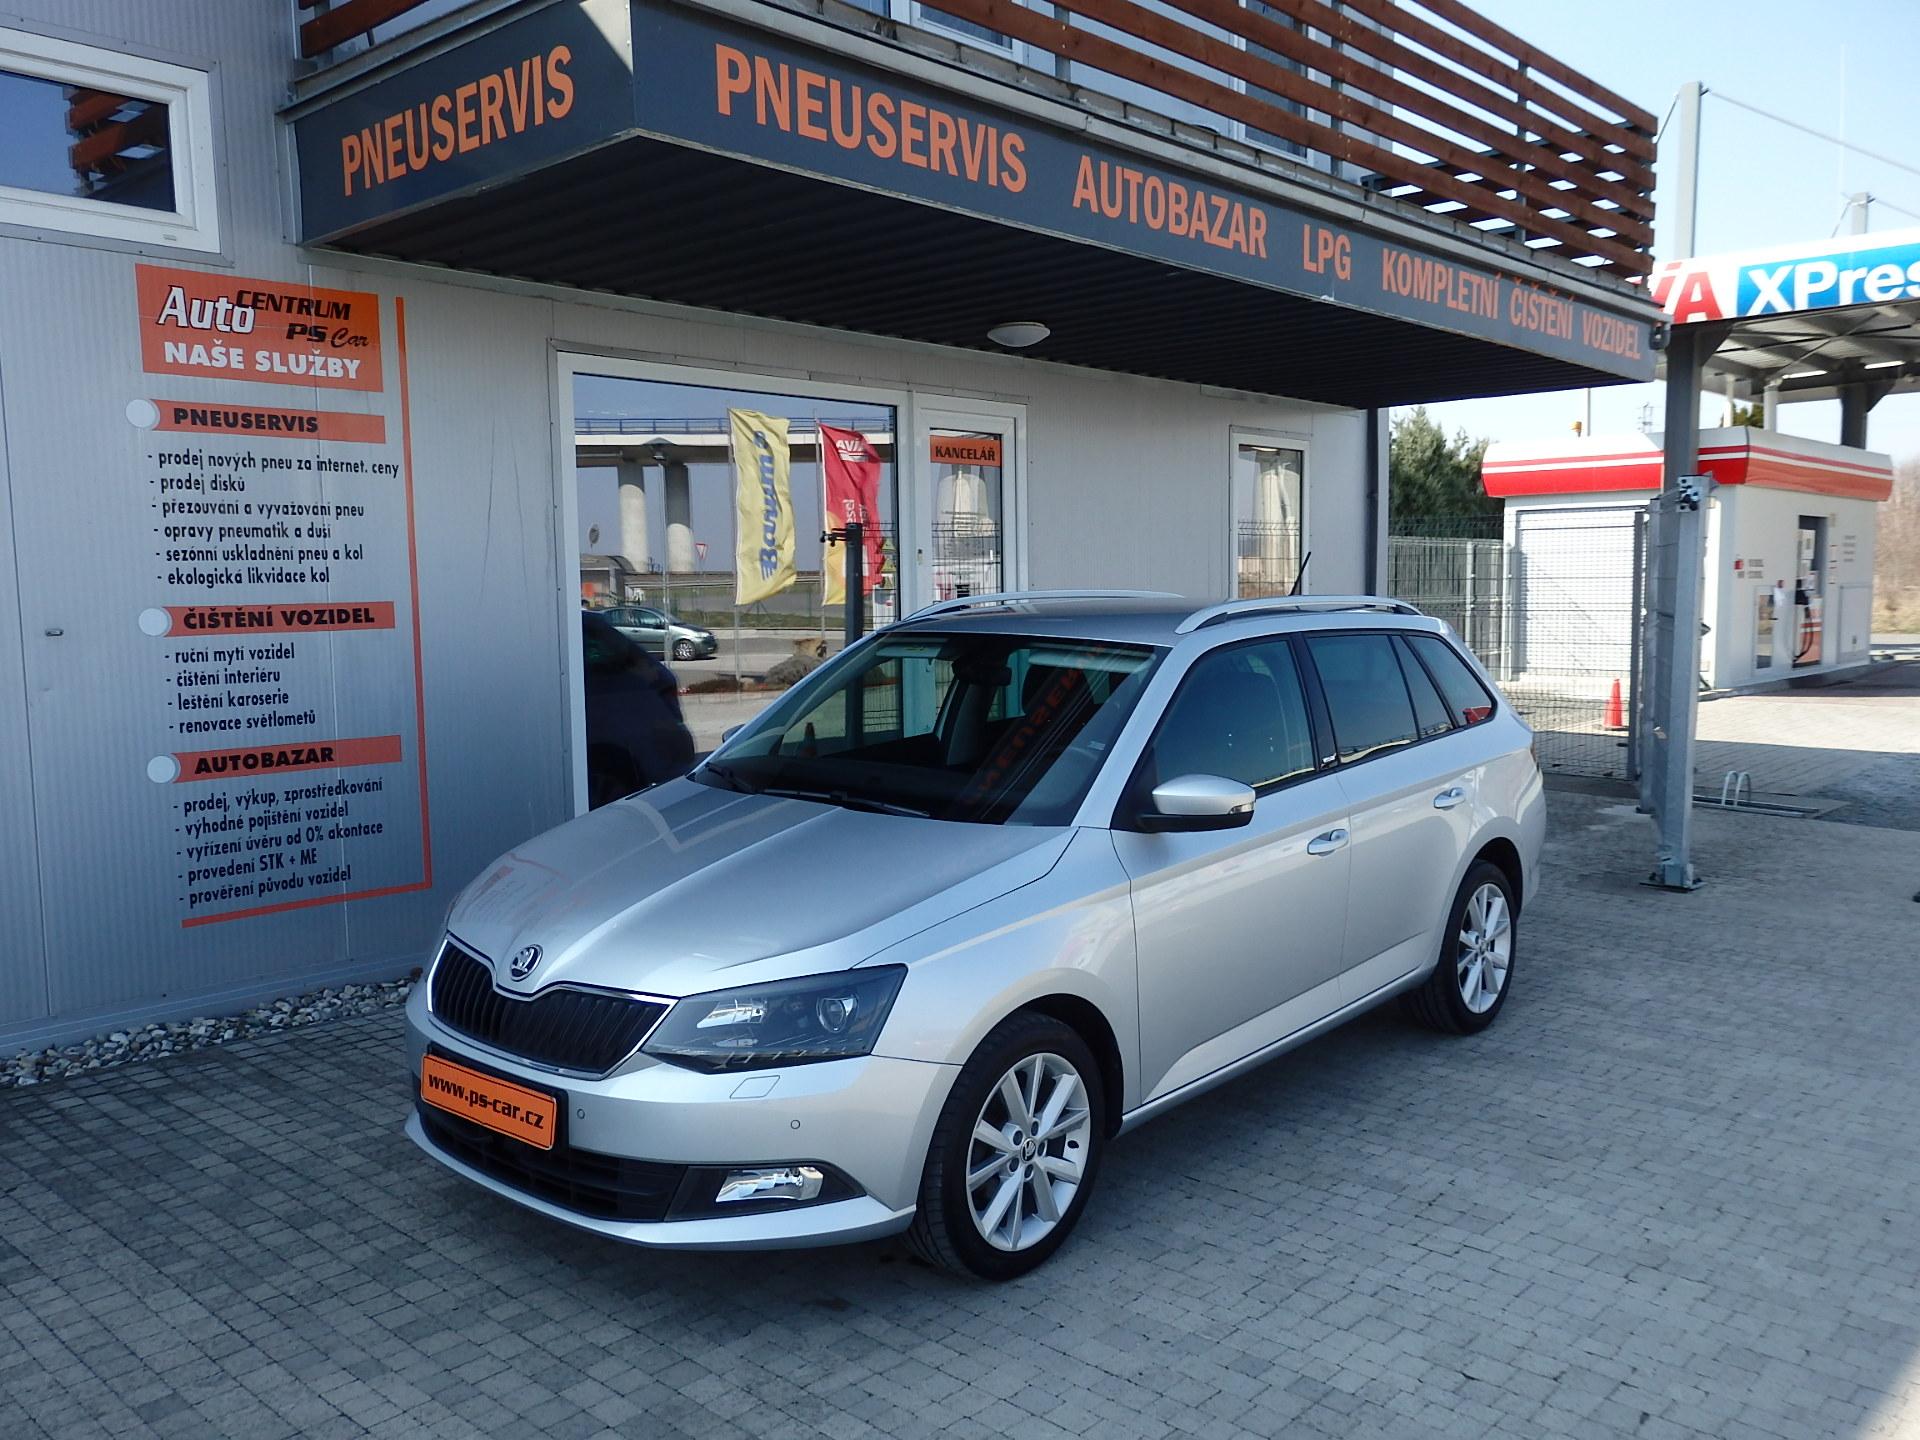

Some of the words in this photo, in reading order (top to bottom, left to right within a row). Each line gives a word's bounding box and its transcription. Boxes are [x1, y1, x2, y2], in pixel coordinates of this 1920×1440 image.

[342, 45, 574, 196] PNEUSERVIS
[715, 43, 1027, 193] PNEUSERVIS
[1072, 155, 1267, 258] AUTOBAZAR
[1303, 224, 1351, 280] LPG
[1382, 248, 1502, 320] KOMPLETNÍ
[1510, 275, 1575, 340] ČIŠTĚNÍ
[1583, 310, 1641, 360] VOZIDEL
[157, 285, 254, 333] Auto
[237, 290, 351, 320] CENTRUM
[286, 323, 328, 342] PS
[331, 327, 369, 348] Car
[164, 339, 244, 370] NAŠE
[255, 349, 360, 379] SLUŽBY
[174, 408, 318, 433] PNEUSERVIS
[159, 448, 203, 470] prodej
[208, 451, 256, 472] nových
[261, 458, 292, 472] pneu
[297, 459, 311, 470] za
[316, 455, 368, 473] internet.
[372, 463, 399, 479] ceny
[935, 446, 995, 461] KANCELÁŘ
[161, 473, 205, 494] prodej
[210, 474, 245, 491] disků
[244, 503, 252, 515] a
[335, 505, 364, 520] pneu
[759, 455, 778, 580] Barum
[164, 526, 213, 542] opravy
[219, 521, 289, 542] pneumatik
[294, 527, 302, 538] a
[166, 546, 217, 561] sezónní
[222, 543, 293, 561] uskladnění
[298, 549, 328, 565] pneu
[333, 549, 340, 560] a
[345, 543, 363, 560] kol
[168, 567, 242, 589] ekologická
[248, 566, 306, 584] likvidace
[311, 565, 330, 583] kol
[184, 606, 273, 629] ČIŠTĚNÍ
[280, 608, 375, 626] VOZIDEL
[175, 647, 208, 663] ruční
[249, 642, 295, 660] vozidel
[177, 669, 220, 687] čištění
[224, 666, 280, 684] interiéru
[178, 692, 223, 710] leštění
[228, 688, 289, 707] karoserie
[179, 719, 241, 733] renovace
[246, 709, 316, 728] světlometů
[195, 747, 334, 774] AUTOBAZAR
[184, 792, 230, 817] prodej,
[236, 788, 279, 810] výkup,
[284, 777, 382, 804] zprostředkování
[185, 814, 244, 839] výhodné
[249, 808, 301, 832] pojištění
[305, 801, 349, 821] vozidel
[186, 837, 242, 862] vyřízení
[246, 834, 282, 850] úvěru
[287, 828, 301, 845] od
[306, 825, 324, 842] 0%
[328, 823, 383, 840] akontace
[188, 857, 255, 886] provedení
[260, 853, 284, 871] STK
[301, 848, 317, 865] ME
[189, 880, 254, 908] prověření
[258, 872, 304, 897] původu
[308, 865, 351, 886] vozidel
[428, 1074, 544, 1129] www.ps-car.cz
